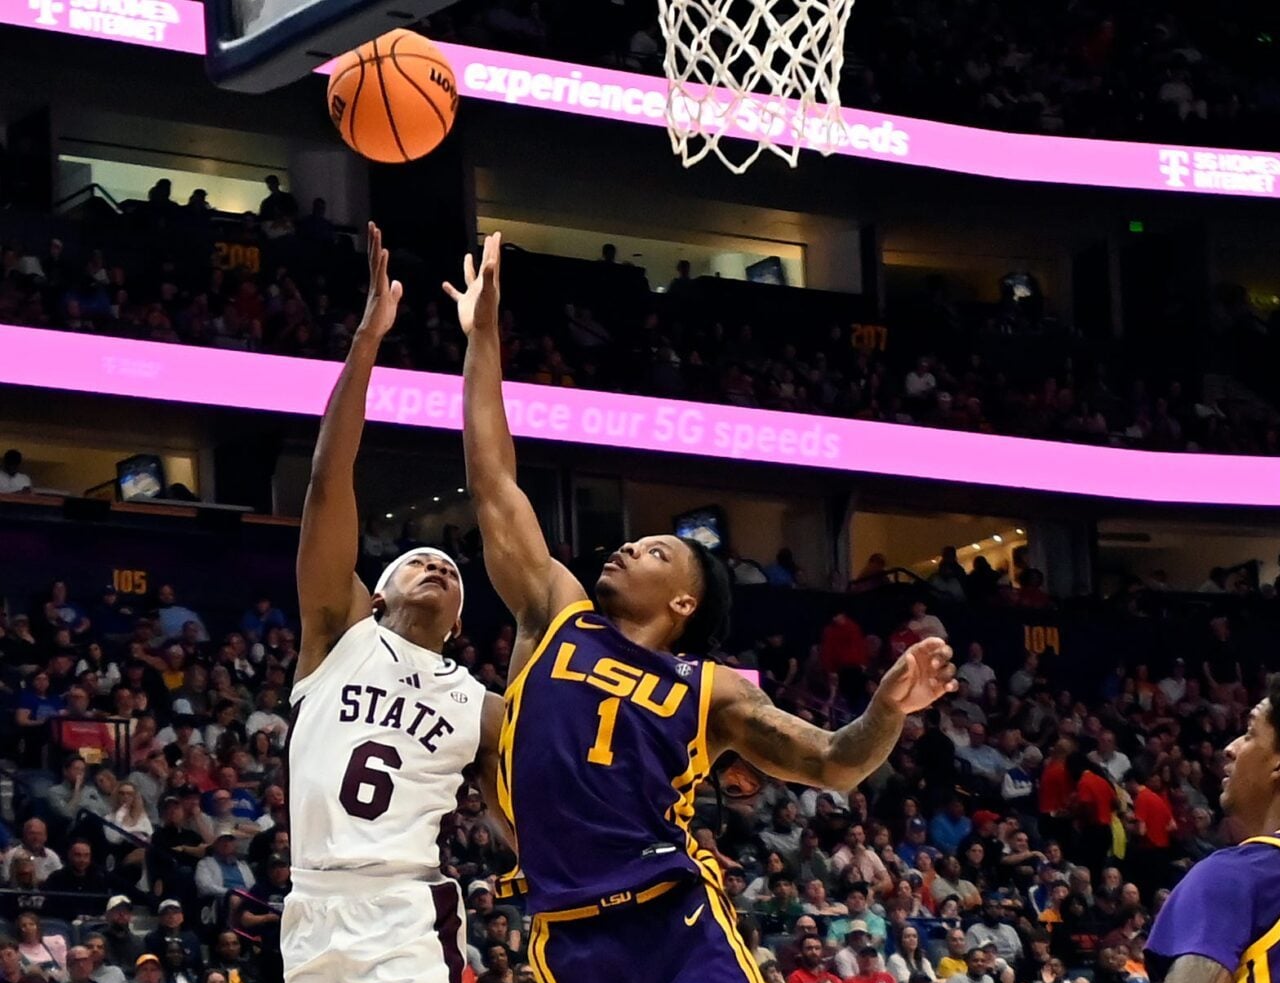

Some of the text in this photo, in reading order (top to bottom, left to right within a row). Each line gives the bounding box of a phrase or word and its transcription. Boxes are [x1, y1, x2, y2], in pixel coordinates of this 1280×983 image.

[464, 61, 667, 116] experience
[580, 406, 645, 438] our
[652, 404, 705, 445] 5G
[713, 419, 841, 459] speeds
[112, 569, 147, 594] 105
[1023, 625, 1060, 656] 104
[550, 641, 690, 718] LSU
[339, 684, 455, 753] STATE
[587, 696, 621, 767] 1
[339, 740, 403, 821] 6
[600, 890, 632, 908] LSU
